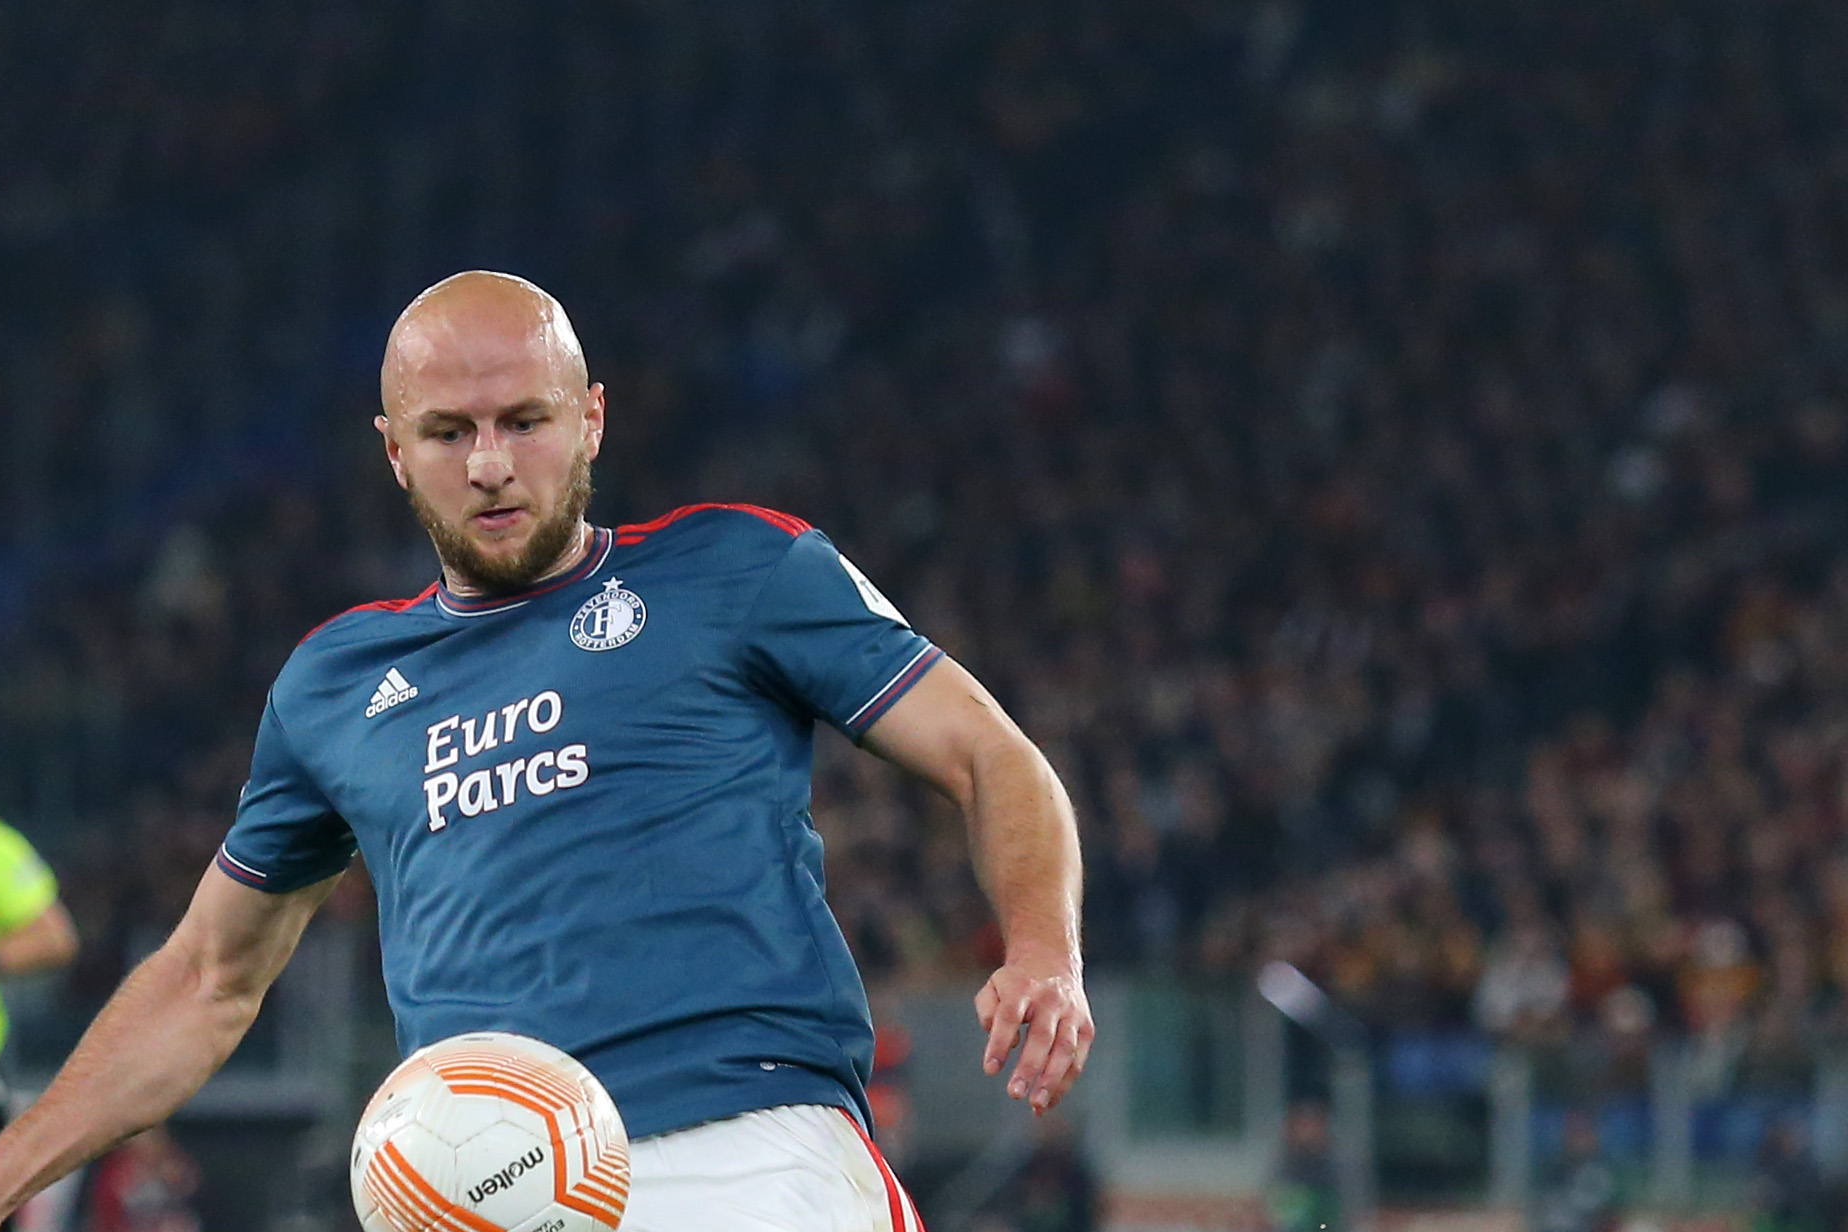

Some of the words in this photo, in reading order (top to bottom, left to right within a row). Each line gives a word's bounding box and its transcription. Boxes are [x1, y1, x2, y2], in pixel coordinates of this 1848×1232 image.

[365, 686, 419, 718] adidas
[424, 690, 562, 774] Euro
[423, 744, 589, 832] Parcs
[467, 1146, 544, 1204] molten
